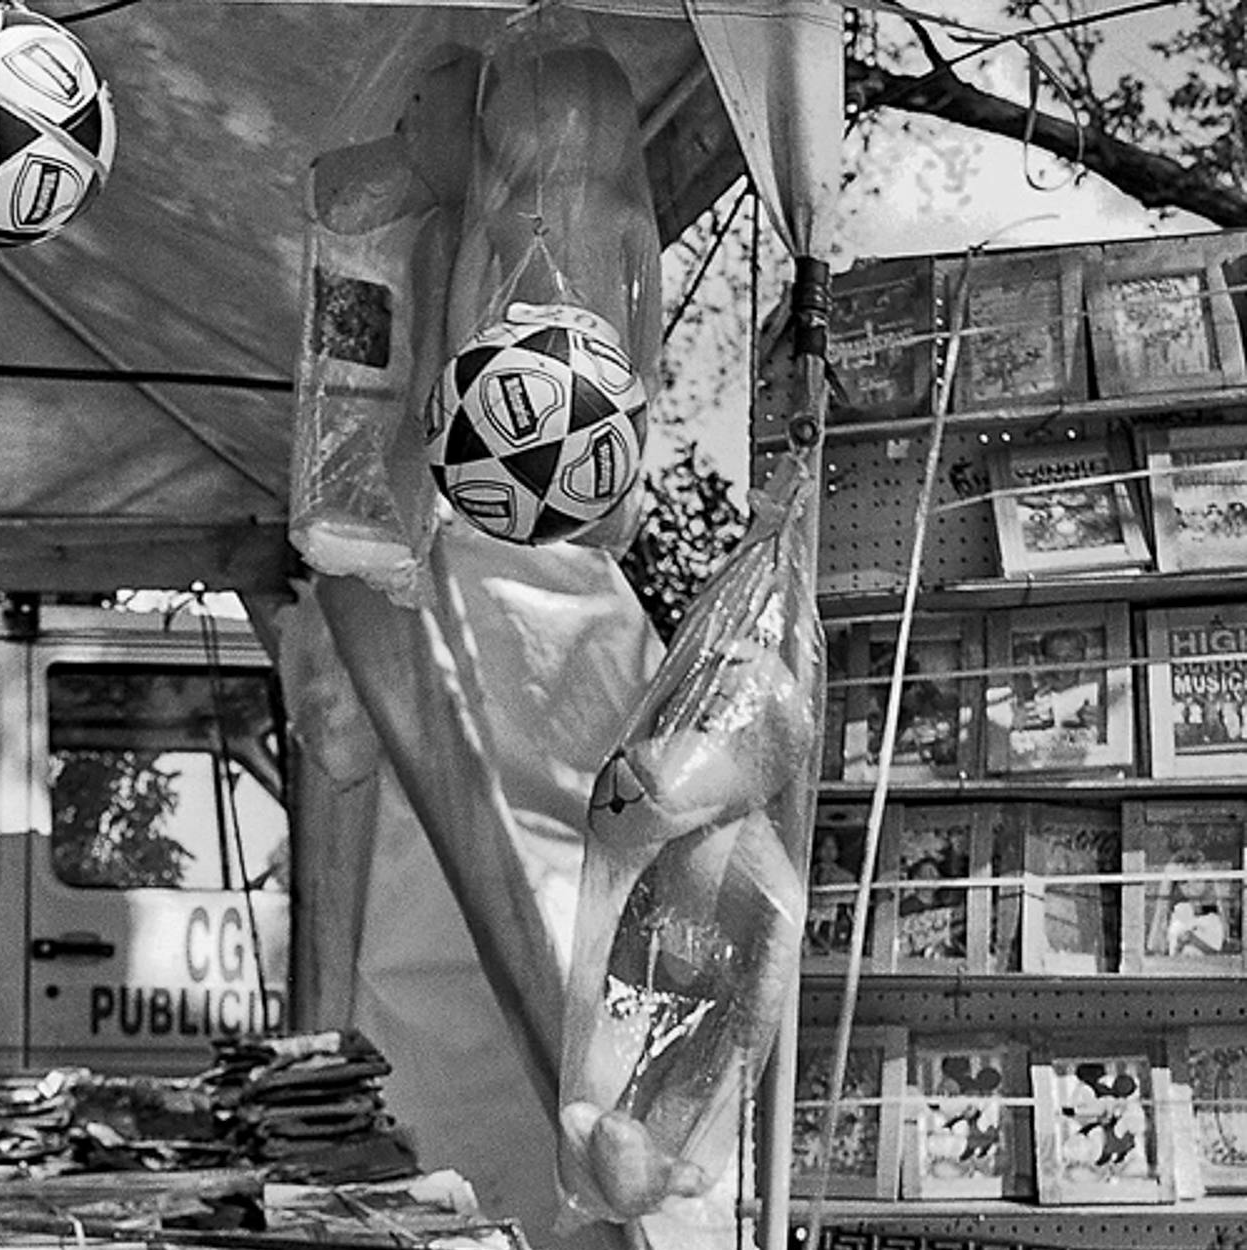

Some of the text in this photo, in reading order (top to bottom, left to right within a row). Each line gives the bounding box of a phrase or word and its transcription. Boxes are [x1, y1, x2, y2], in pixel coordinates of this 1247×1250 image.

[1173, 672, 1247, 695] MUSIC
[186, 906, 244, 983] CG
[90, 985, 285, 1037] PUBLICID
